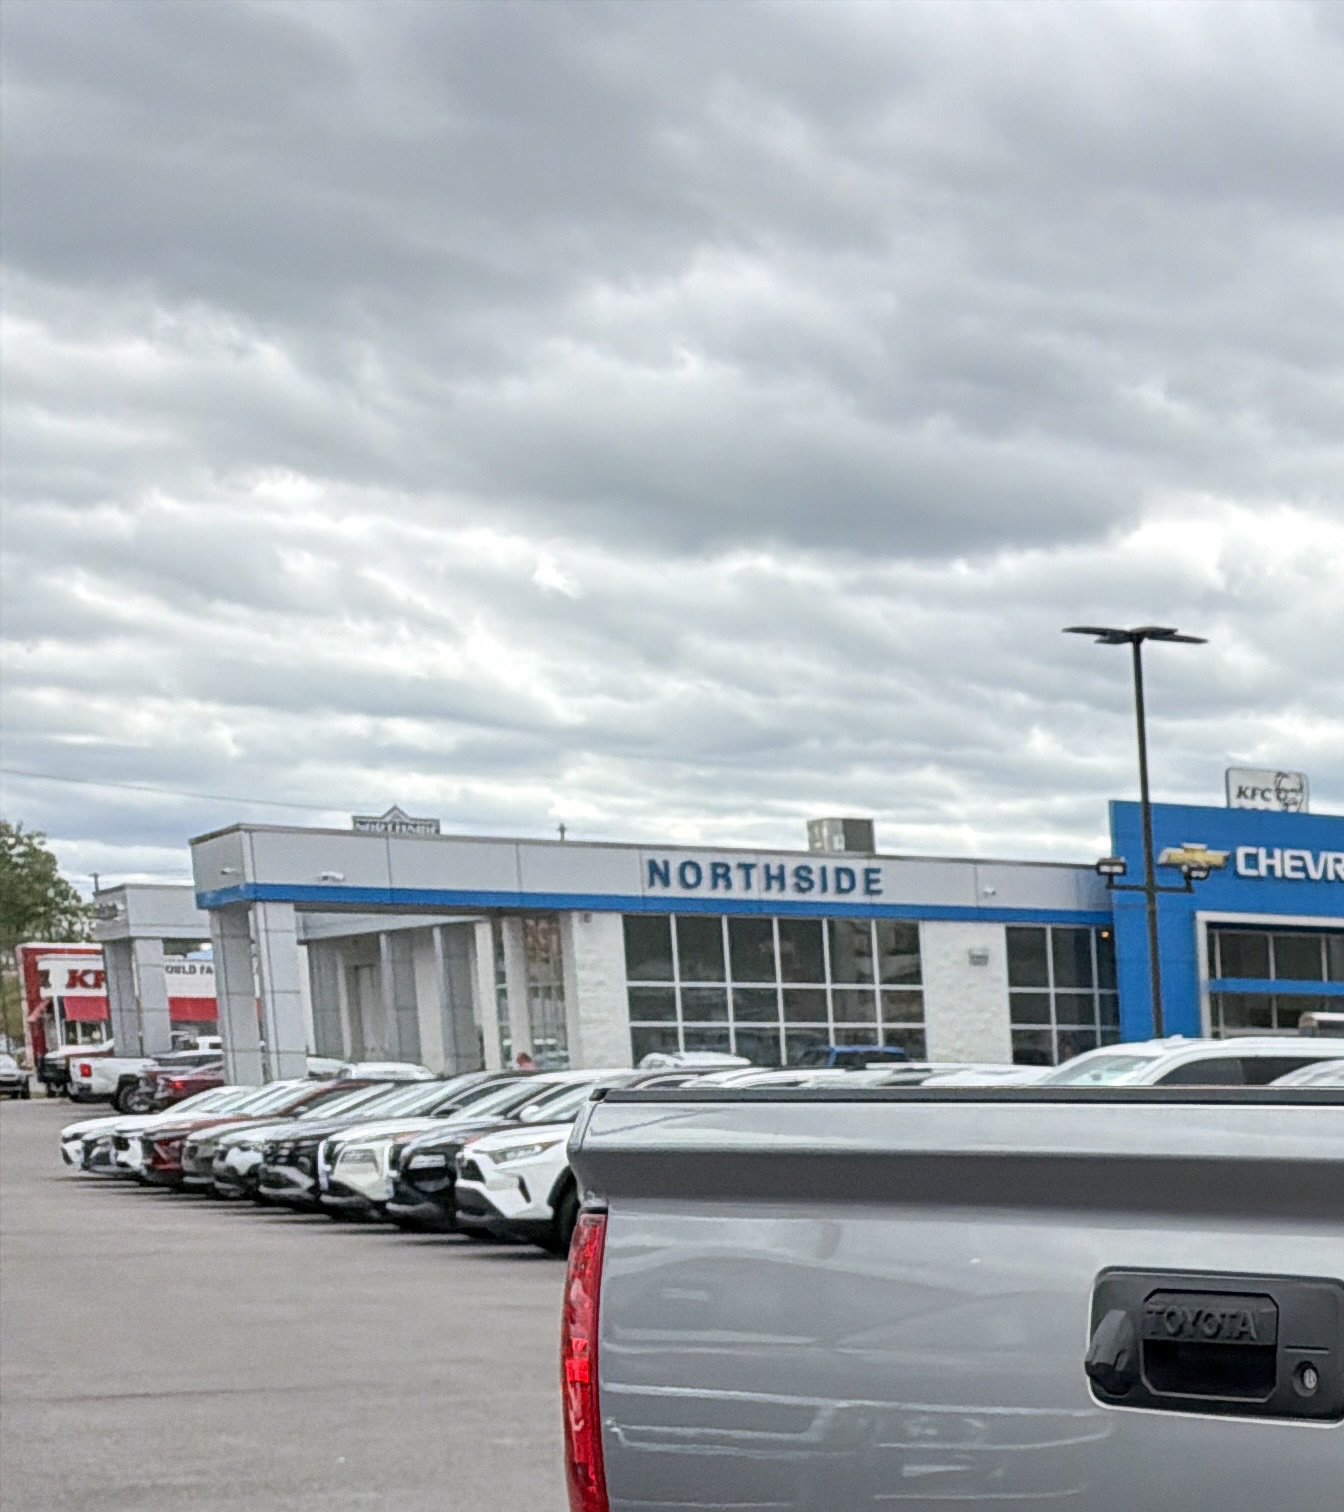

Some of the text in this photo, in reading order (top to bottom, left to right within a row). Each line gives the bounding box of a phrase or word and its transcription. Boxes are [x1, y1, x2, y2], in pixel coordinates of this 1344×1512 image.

[1236, 785, 1272, 802] KFC
[647, 859, 883, 896] NORTHSIDE
[1146, 1305, 1259, 1341] TOYOTA
